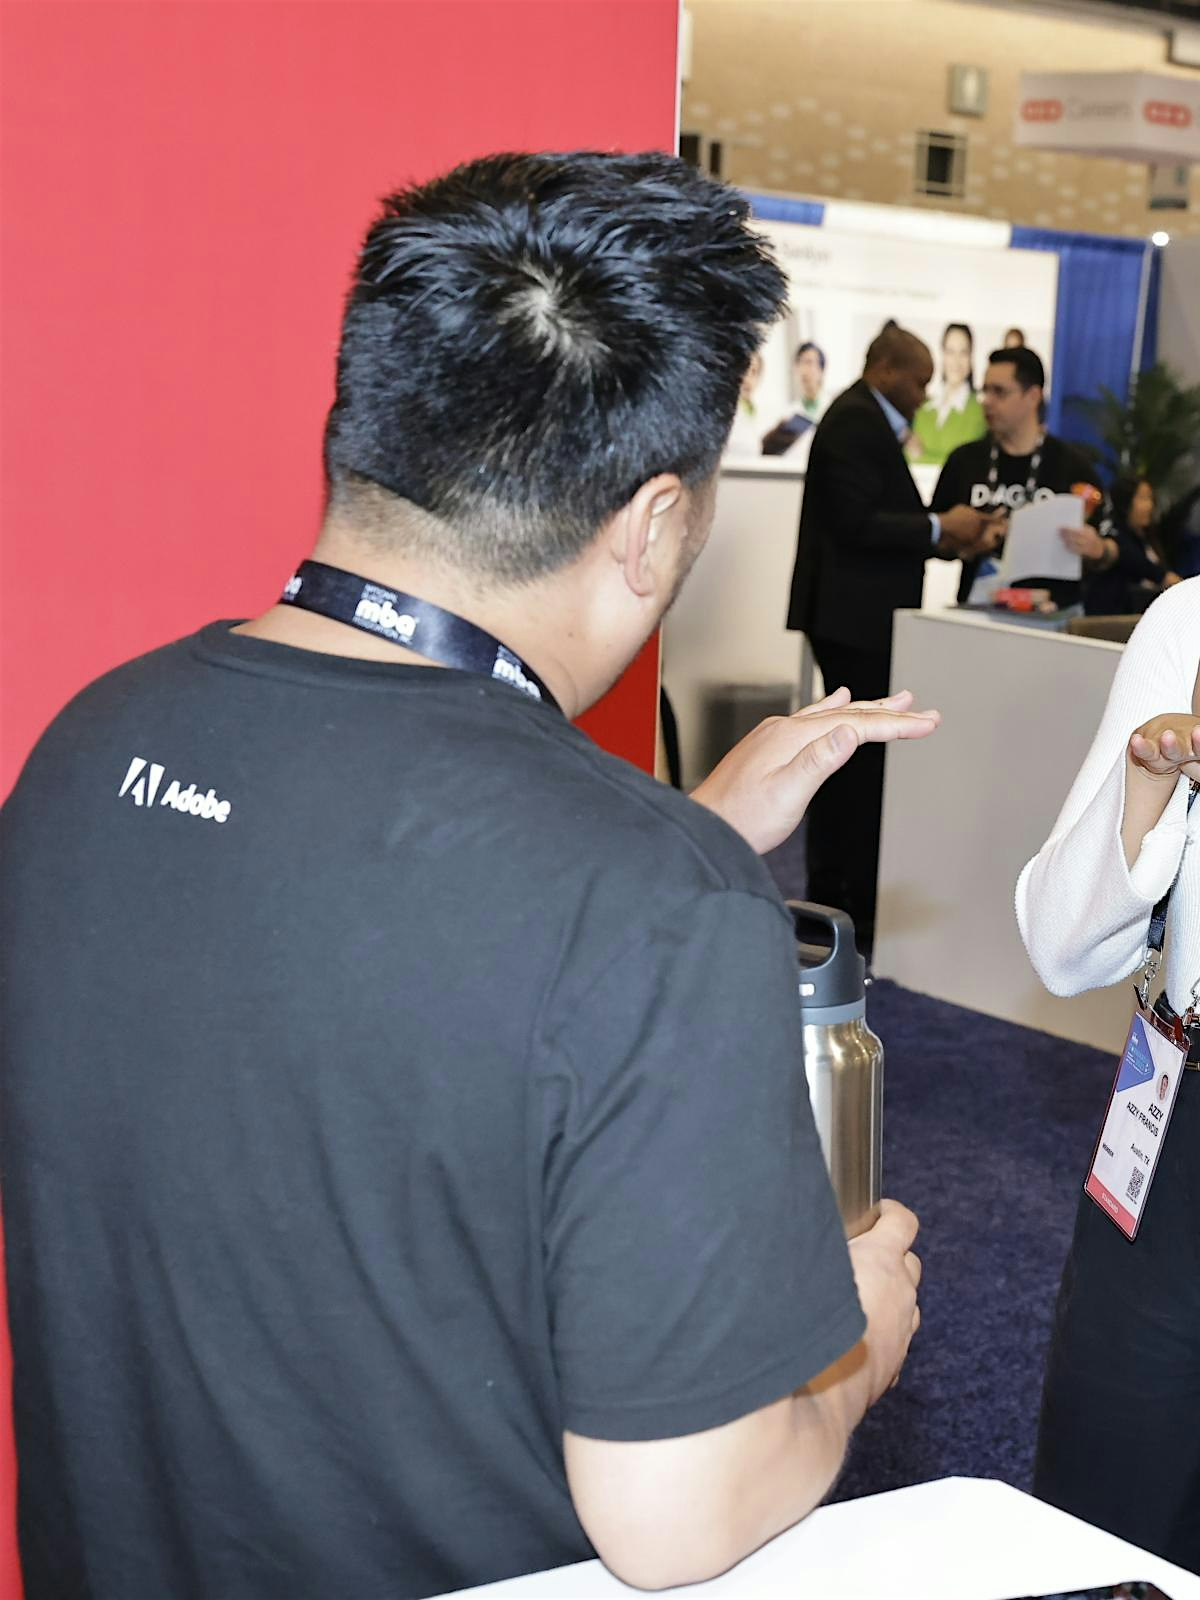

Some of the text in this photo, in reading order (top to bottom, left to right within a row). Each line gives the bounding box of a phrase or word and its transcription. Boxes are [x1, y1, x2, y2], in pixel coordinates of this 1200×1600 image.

[971, 483, 1056, 510] DAGO
[354, 600, 416, 637] mba
[160, 781, 231, 823] Adobe
[1148, 1102, 1164, 1122] AZZY
